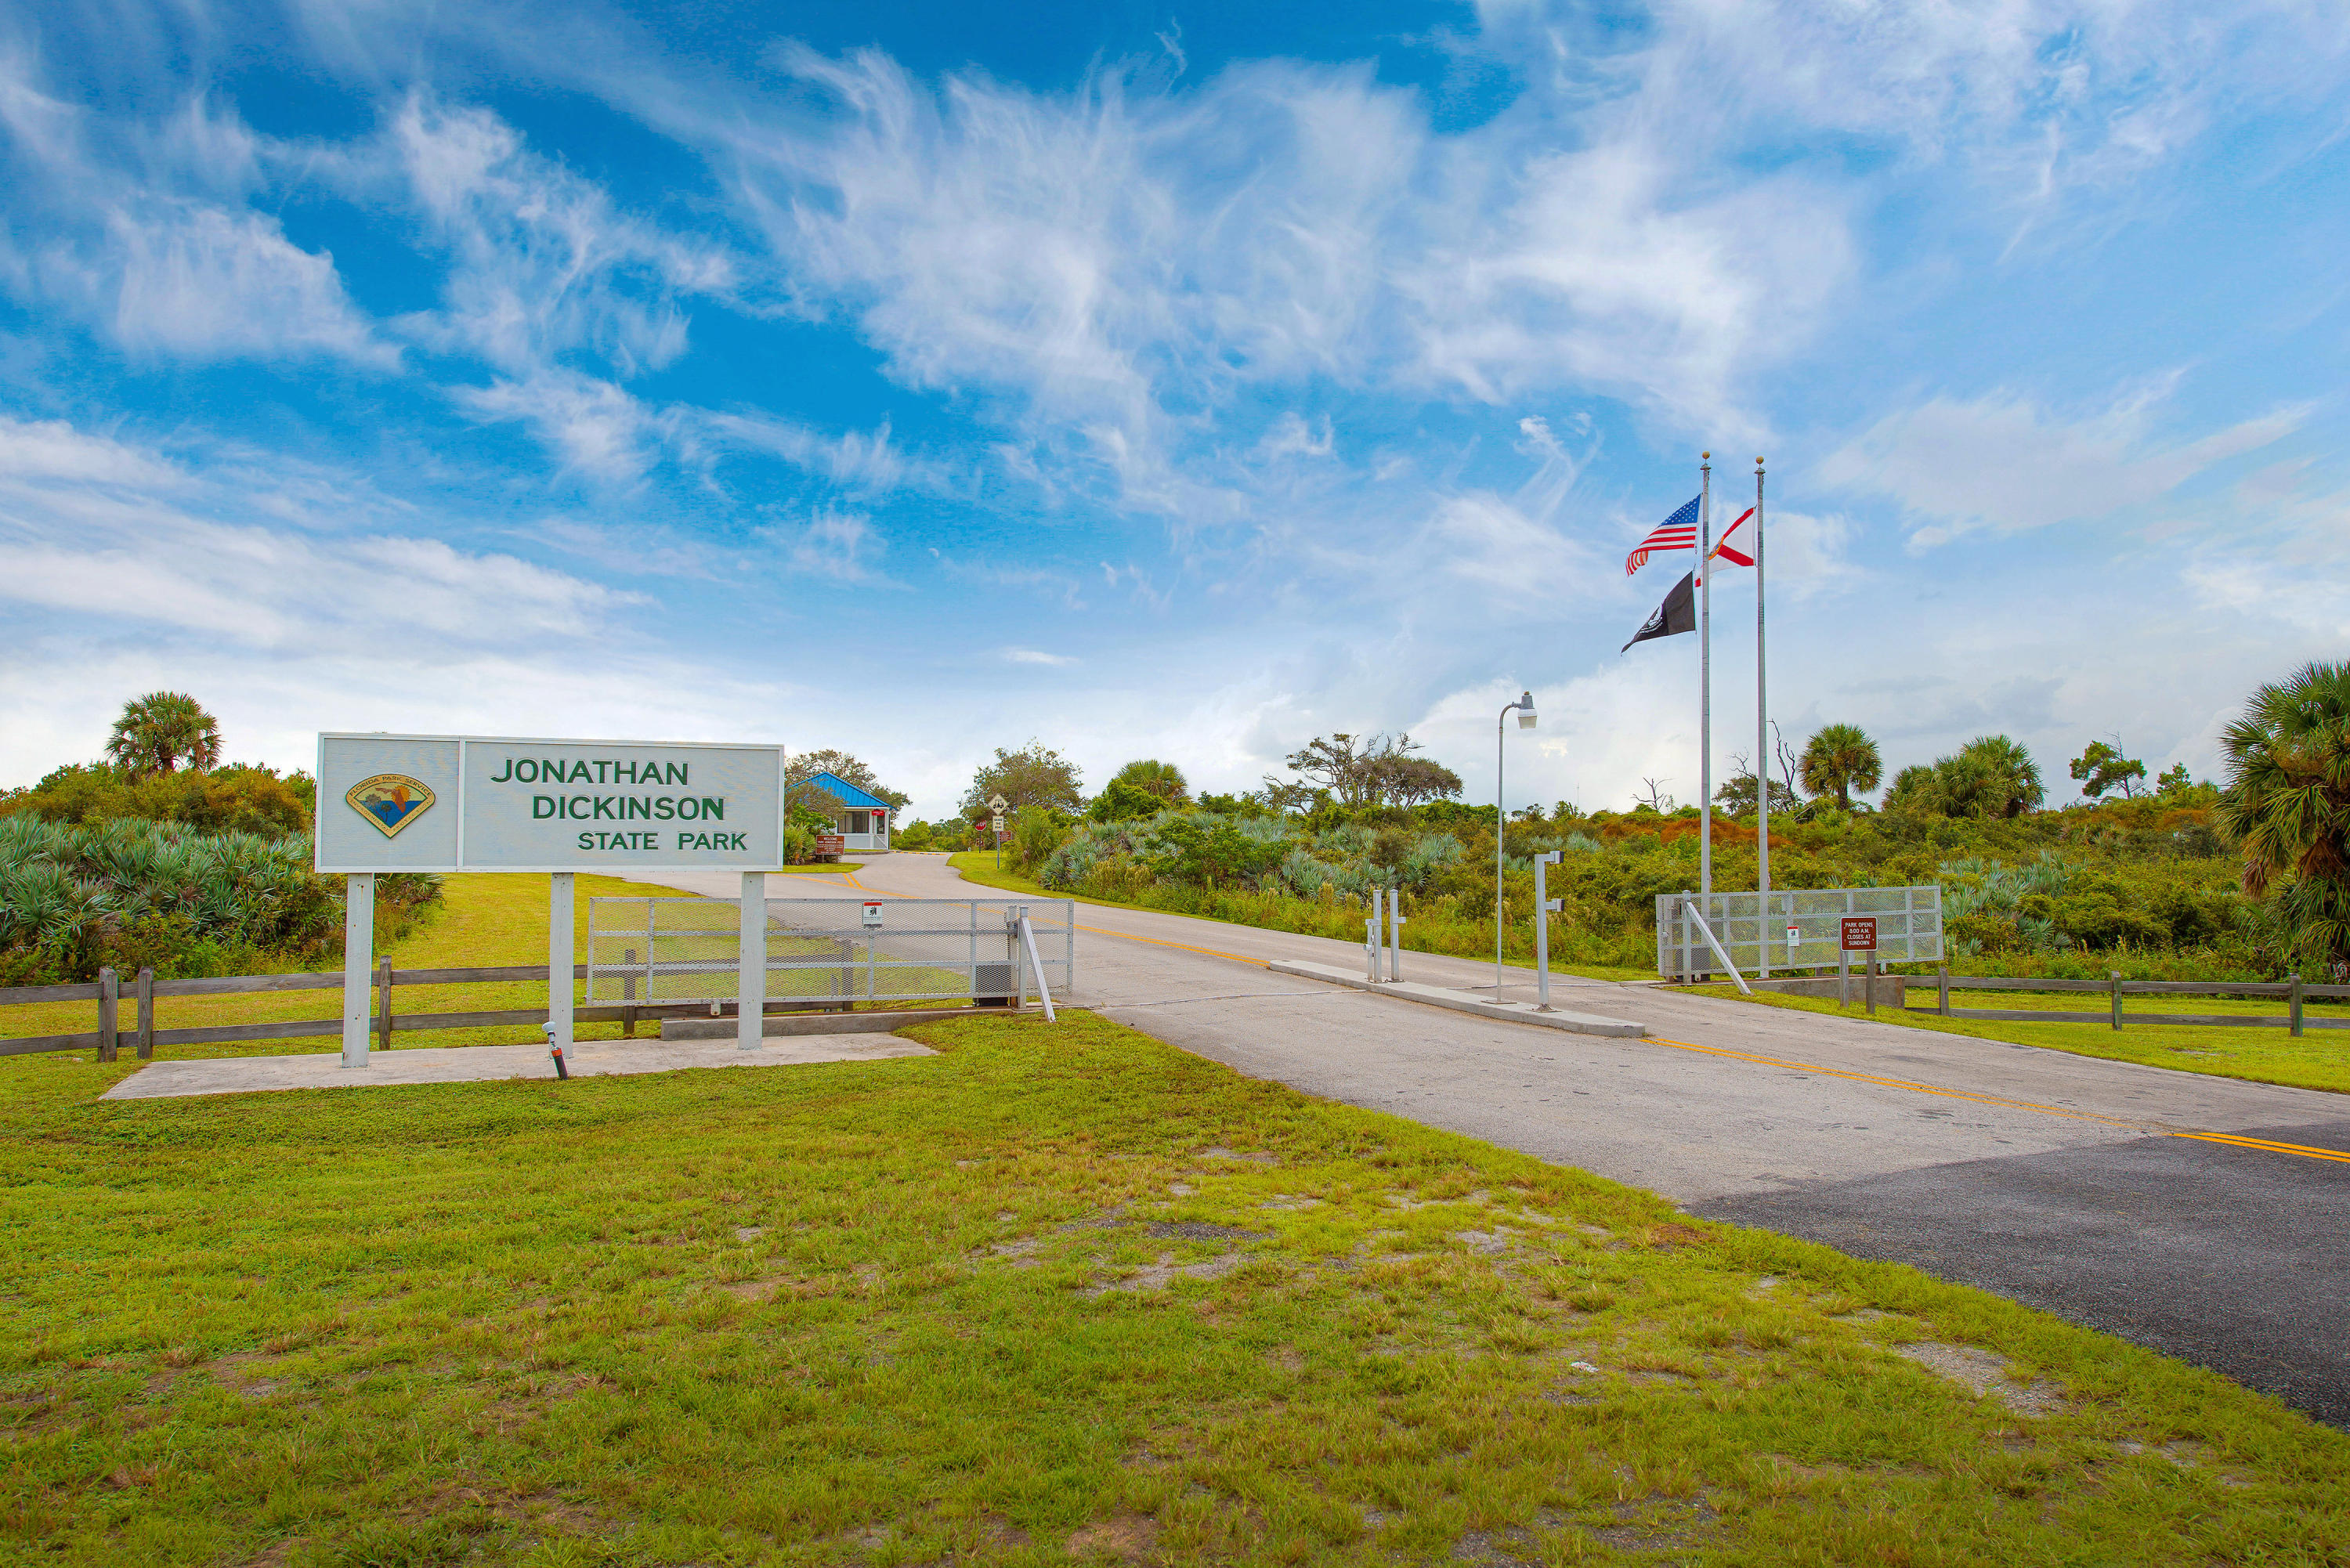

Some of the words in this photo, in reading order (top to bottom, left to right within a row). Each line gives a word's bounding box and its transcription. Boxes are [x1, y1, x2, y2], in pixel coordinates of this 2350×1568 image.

[491, 759, 689, 786] JONATHAN
[349, 778, 379, 797] FLORIDA
[405, 778, 432, 797] SERVICE
[533, 795, 724, 821] DICKINSON
[578, 832, 659, 851] STATE
[678, 832, 747, 851] PARK
